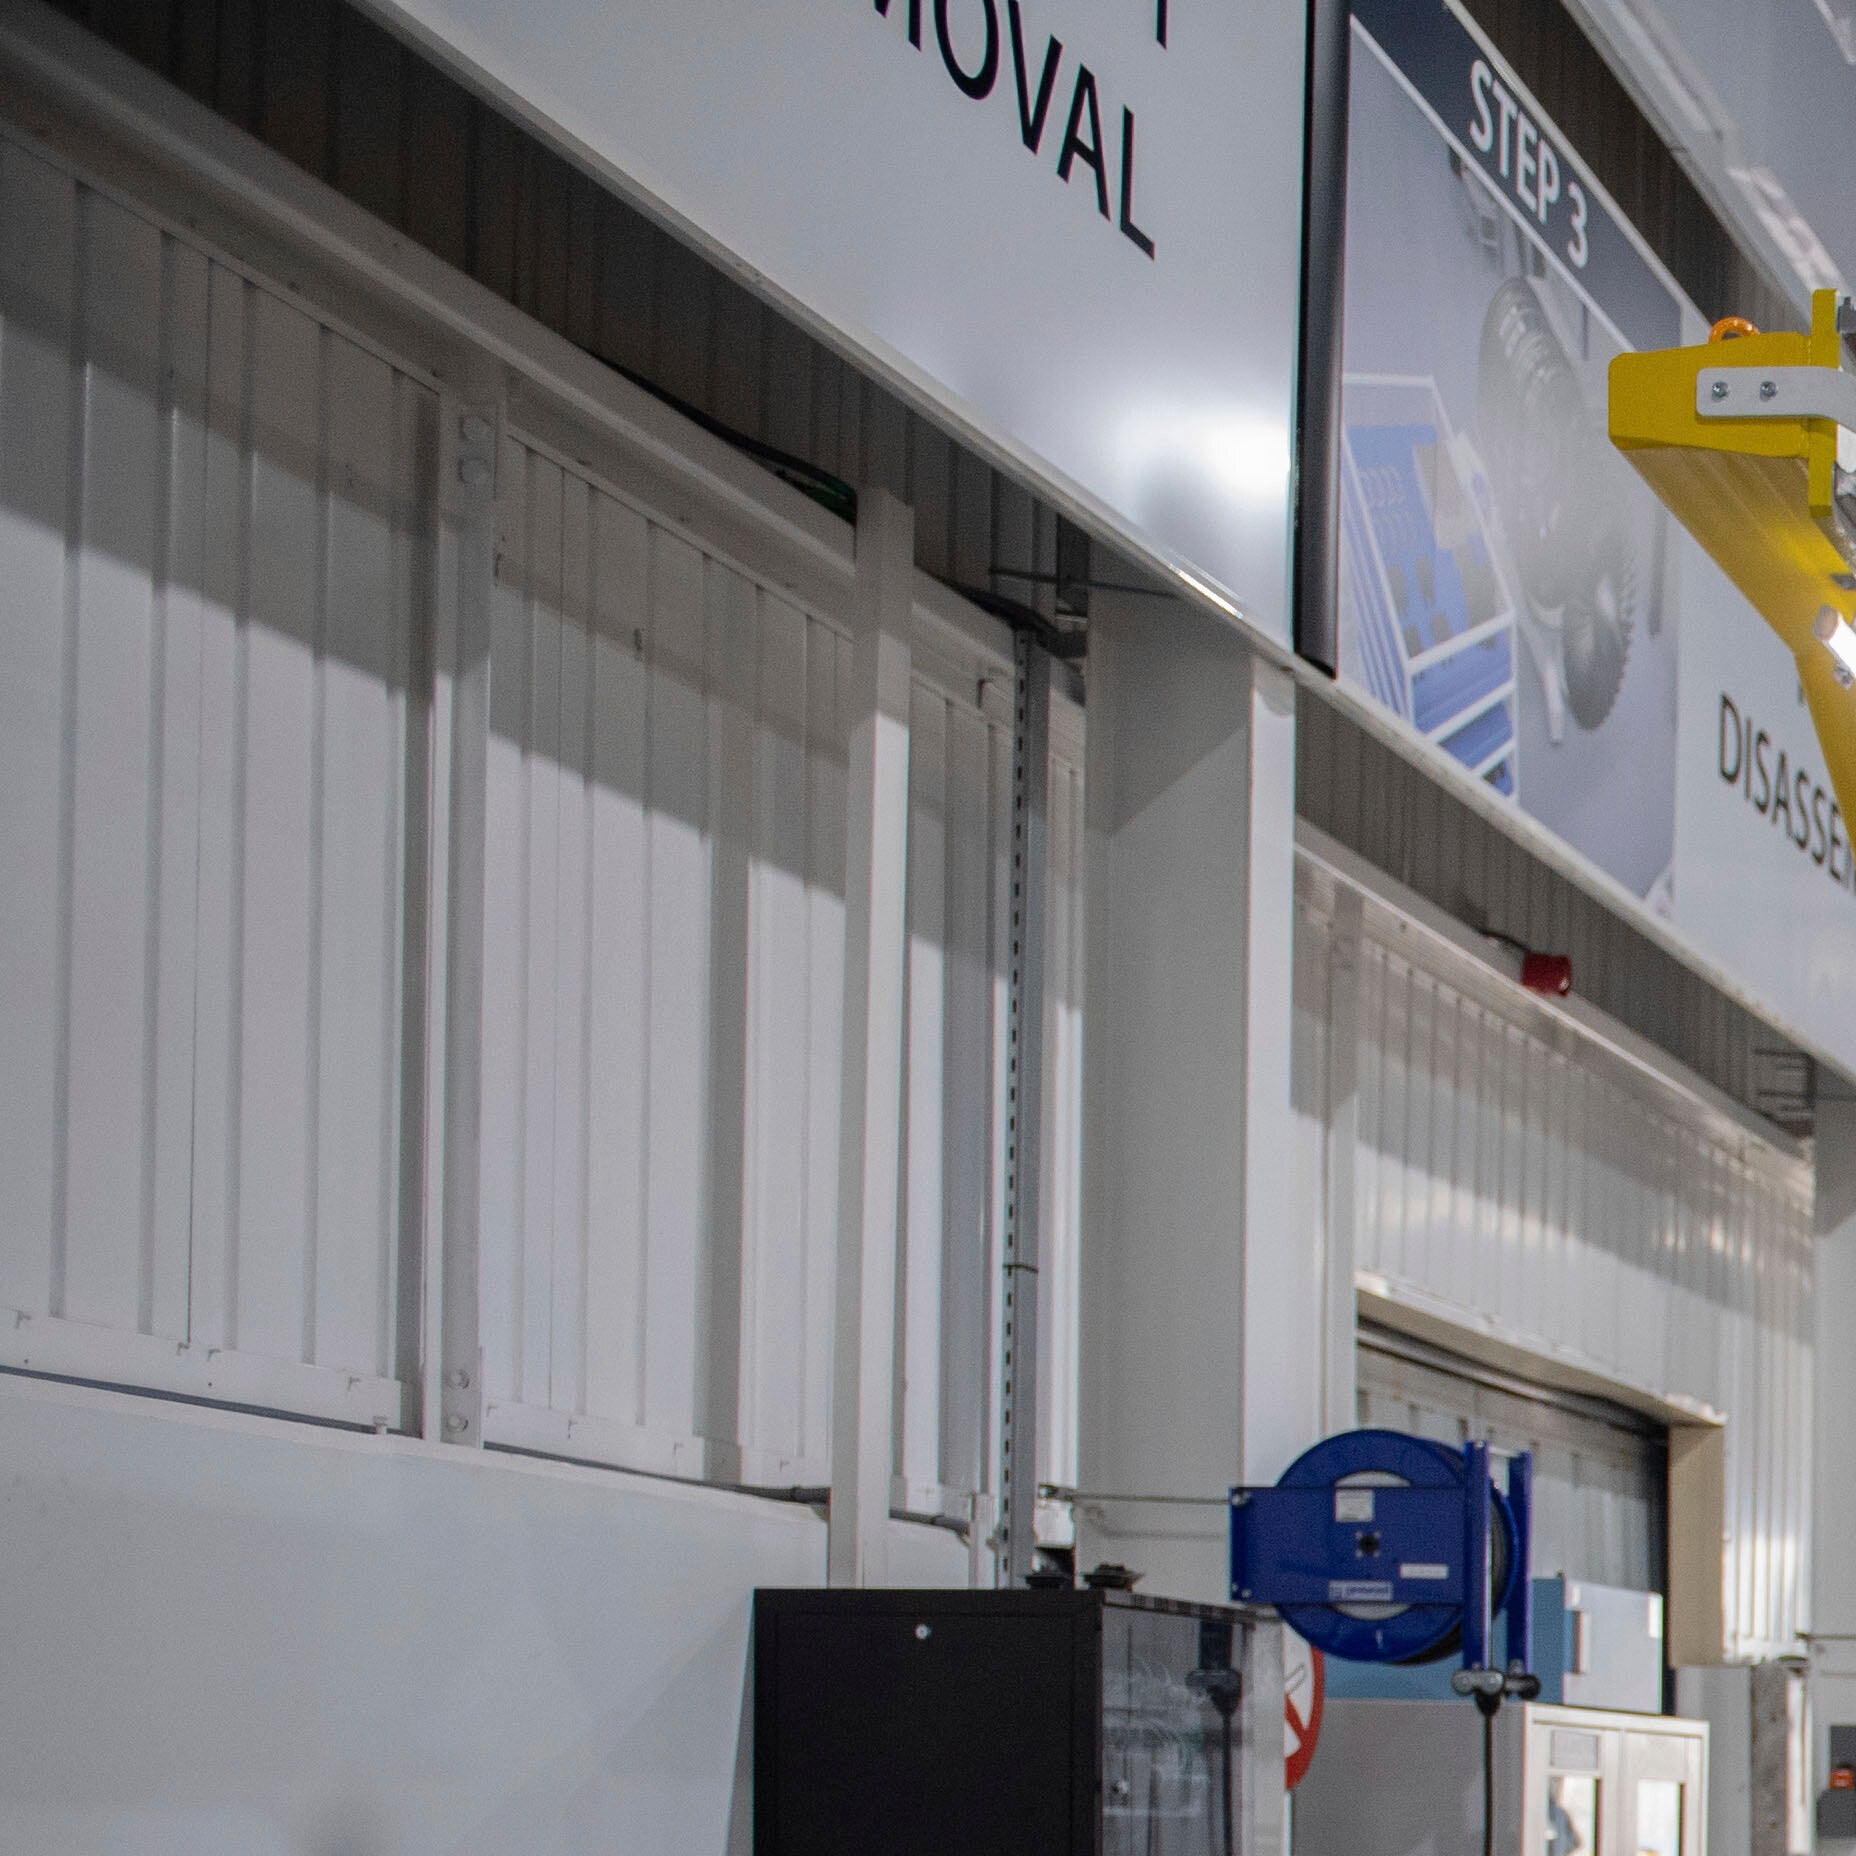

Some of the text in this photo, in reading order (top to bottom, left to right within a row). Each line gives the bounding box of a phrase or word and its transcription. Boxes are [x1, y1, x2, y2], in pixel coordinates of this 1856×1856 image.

[874, 0, 1155, 261] OVAL
[1469, 59, 1589, 268] STEP 3
